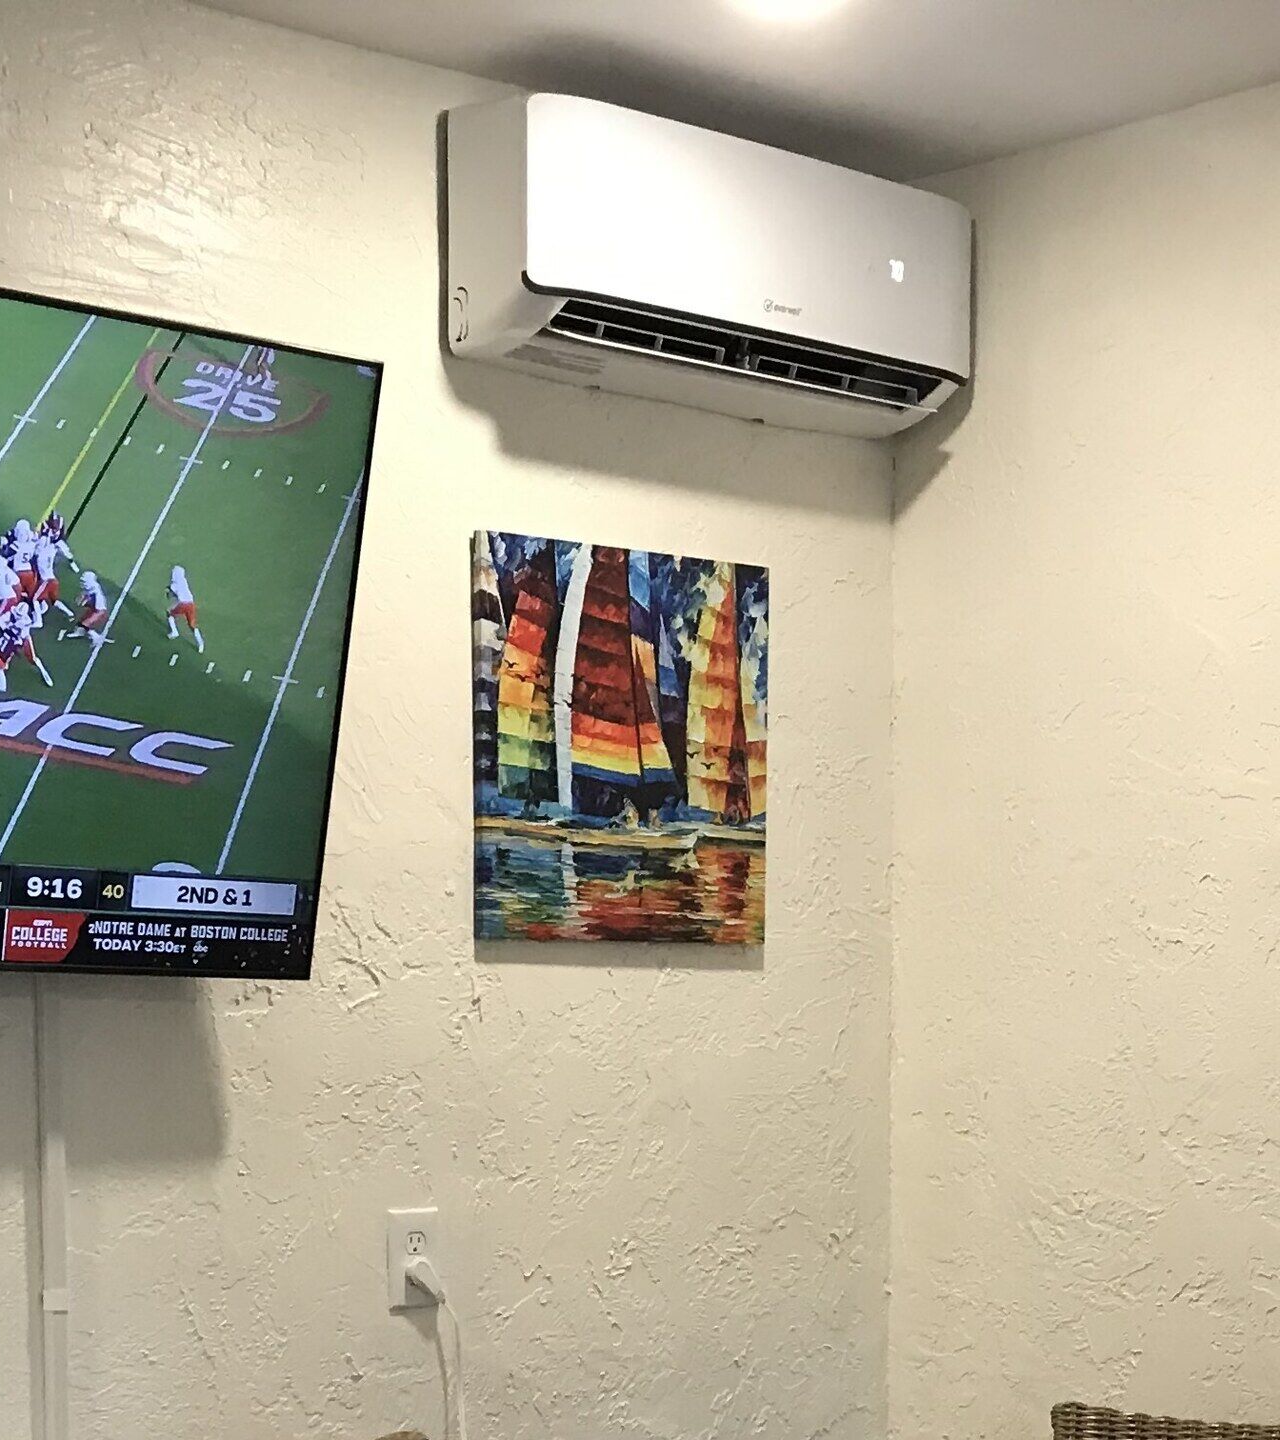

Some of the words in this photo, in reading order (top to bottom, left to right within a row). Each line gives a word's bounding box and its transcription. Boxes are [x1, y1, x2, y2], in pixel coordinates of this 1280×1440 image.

[173, 378, 281, 422] 25
[26, 876, 83, 899] 9:16
[102, 884, 125, 899] 40
[176, 885, 219, 904] 2ND
[222, 888, 238, 906] &
[241, 889, 252, 907] 1
[11, 927, 69, 942] COLLEGE
[137, 923, 171, 938] DAME
[174, 928, 187, 938] AT
[190, 926, 237, 941] BOSTON
[239, 927, 289, 943] COLLEGE
[10, 941, 67, 949] FOOTBALL
[93, 938, 142, 951] TODAY
